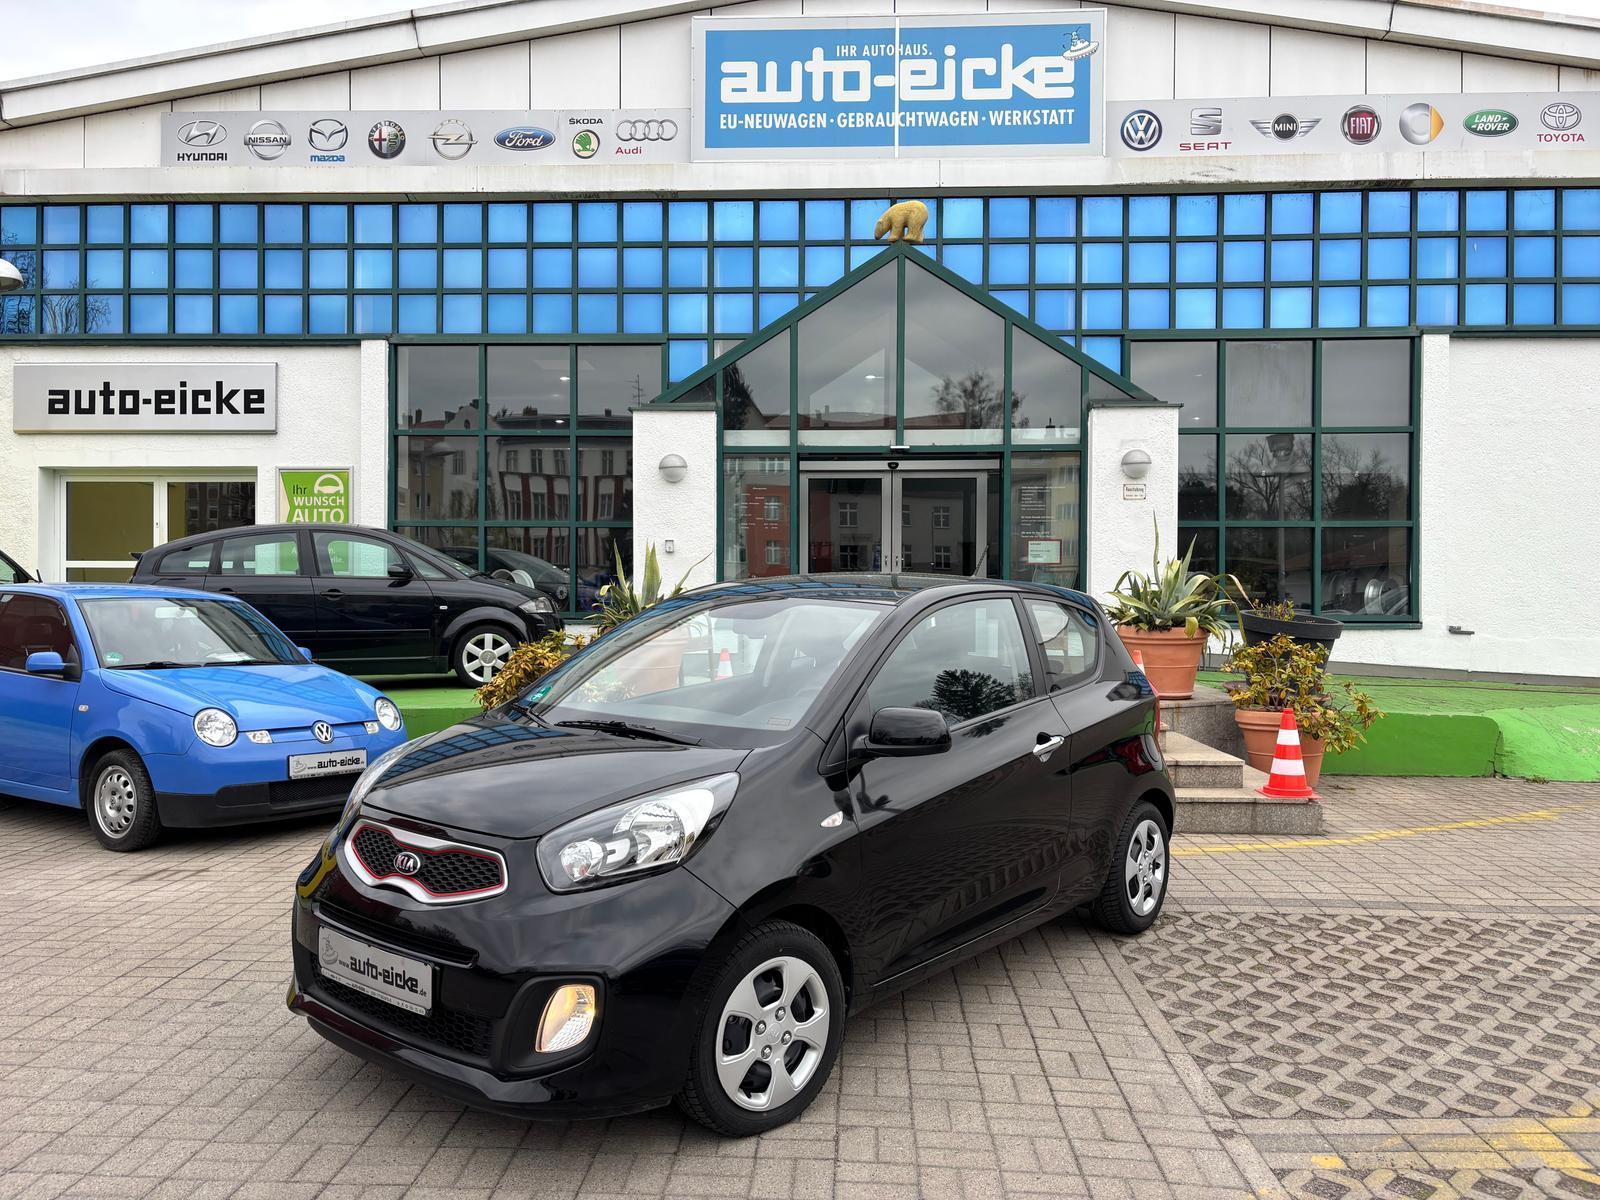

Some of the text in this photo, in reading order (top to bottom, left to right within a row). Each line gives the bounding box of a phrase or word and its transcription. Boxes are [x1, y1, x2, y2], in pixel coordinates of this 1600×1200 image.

[836, 43, 933, 58] IHR AUTOHAUS.
[720, 43, 1075, 103] auto-eicke
[719, 109, 1075, 130] EU-NEUWAGEN GEBRAUCHTWAGEN WERKSTATT
[1274, 123, 1297, 132] MINI
[1350, 117, 1372, 135] FIAT
[248, 136, 287, 144] NISSAN
[505, 131, 543, 147] Ford
[1537, 133, 1585, 142] TOYOTA
[615, 146, 643, 155] Audi
[1179, 141, 1232, 151] SEAT
[177, 152, 228, 162] HYUNDAI
[310, 154, 345, 162] mazda
[48, 380, 265, 415] auto-eicke
[292, 484, 307, 495] Ihr
[294, 496, 344, 506] WUNSCH
[292, 508, 345, 523] AUTO
[396, 854, 414, 872] KIA
